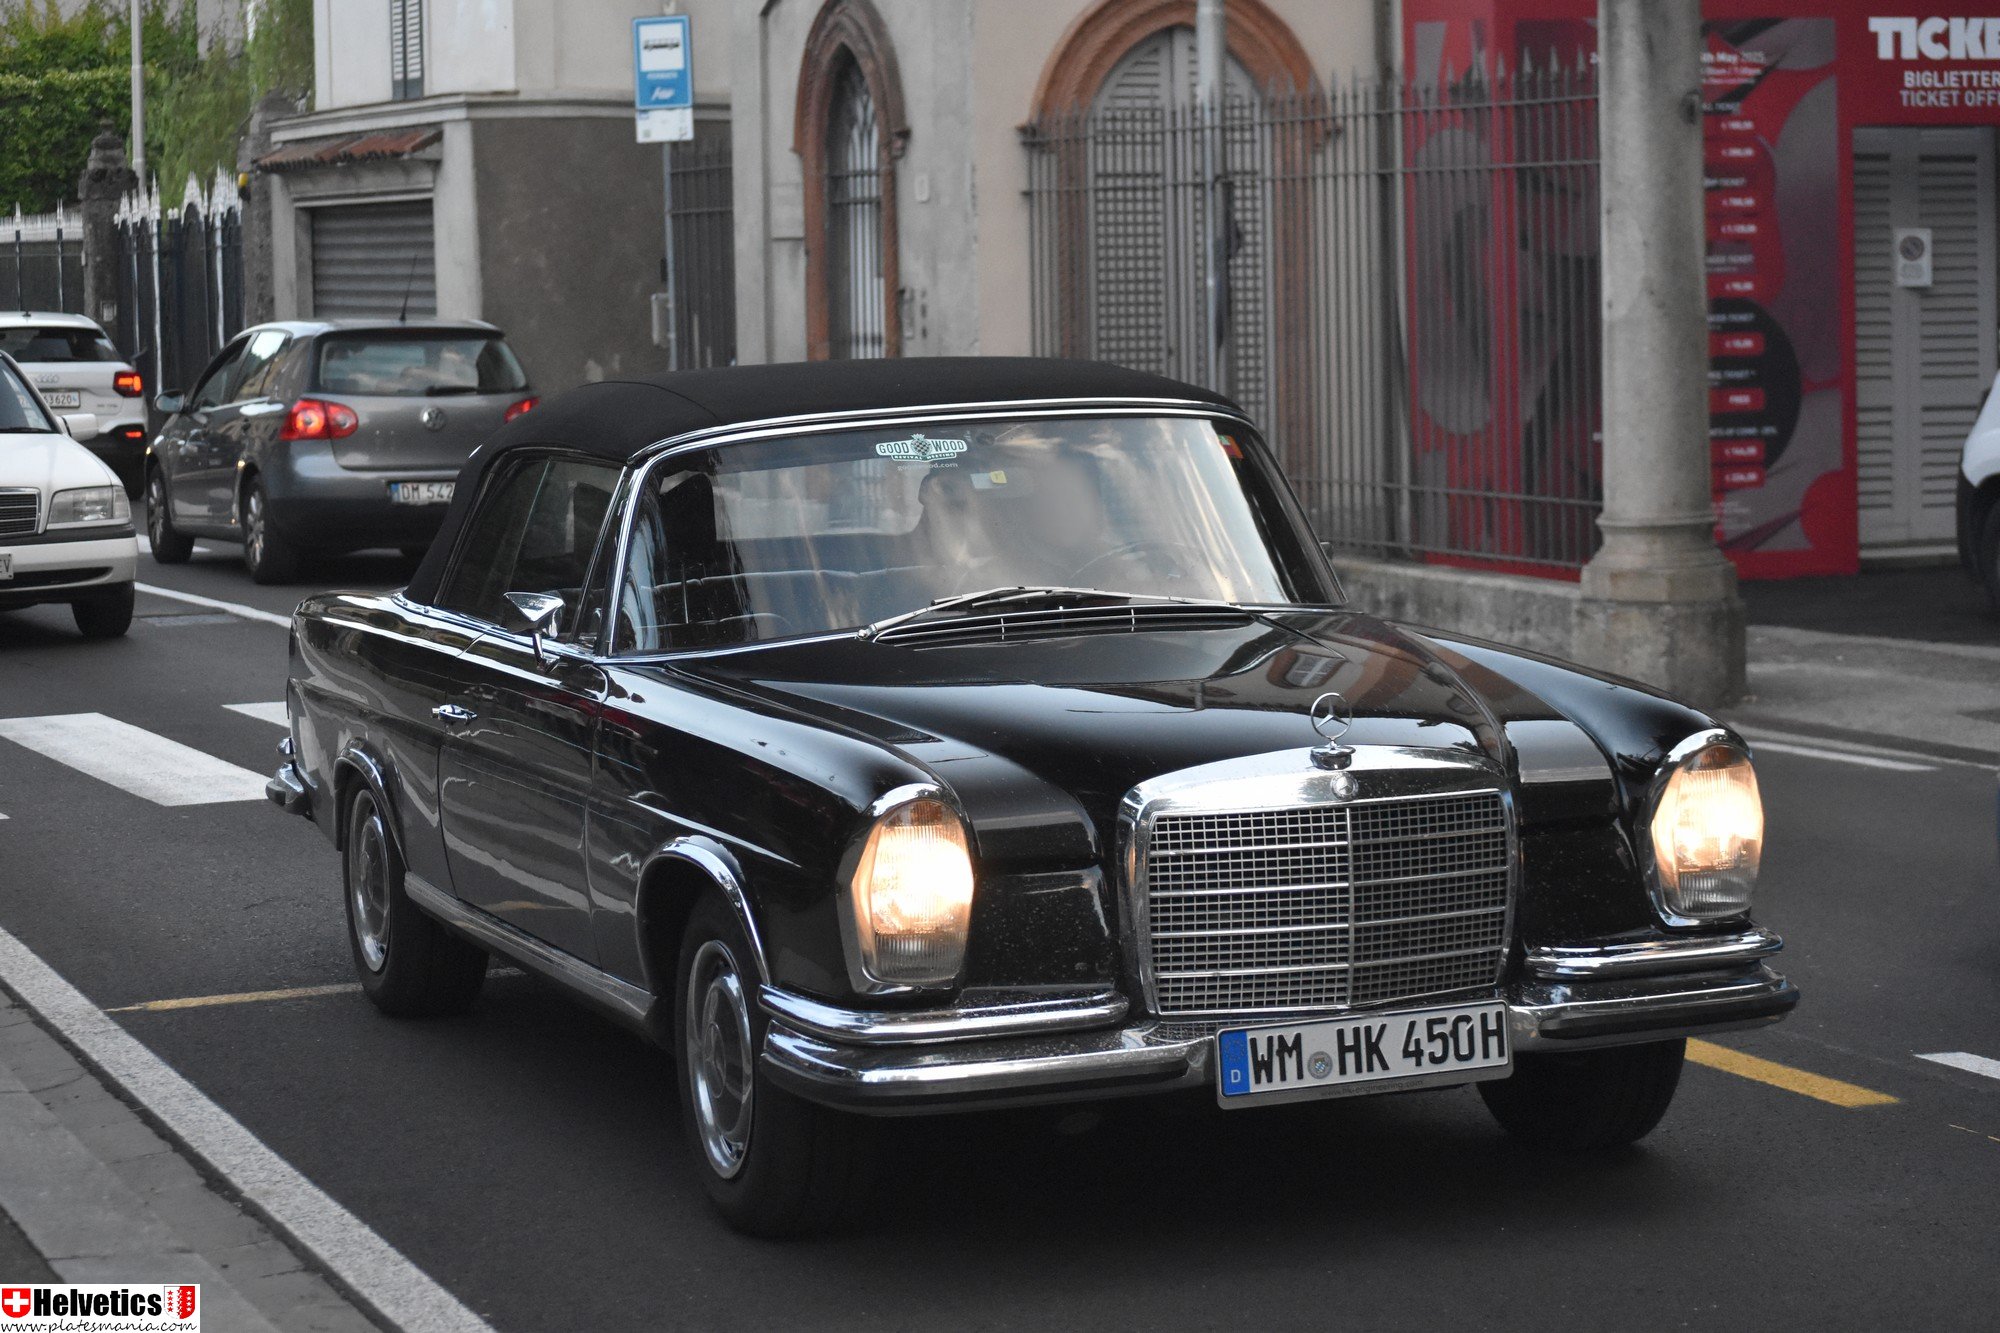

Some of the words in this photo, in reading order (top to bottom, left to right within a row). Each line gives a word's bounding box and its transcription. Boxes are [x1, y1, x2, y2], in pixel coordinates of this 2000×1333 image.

[1900, 91, 1960, 107] TICKET
[879, 442, 910, 454] GOOD
[931, 440, 965, 452] WOOD
[897, 462, 959, 471] goood.com
[402, 484, 420, 500] DM
[1250, 1033, 1304, 1084] WM
[1337, 1023, 1390, 1075] HK
[1402, 1010, 1505, 1067] 450H
[1230, 1069, 1242, 1084] D
